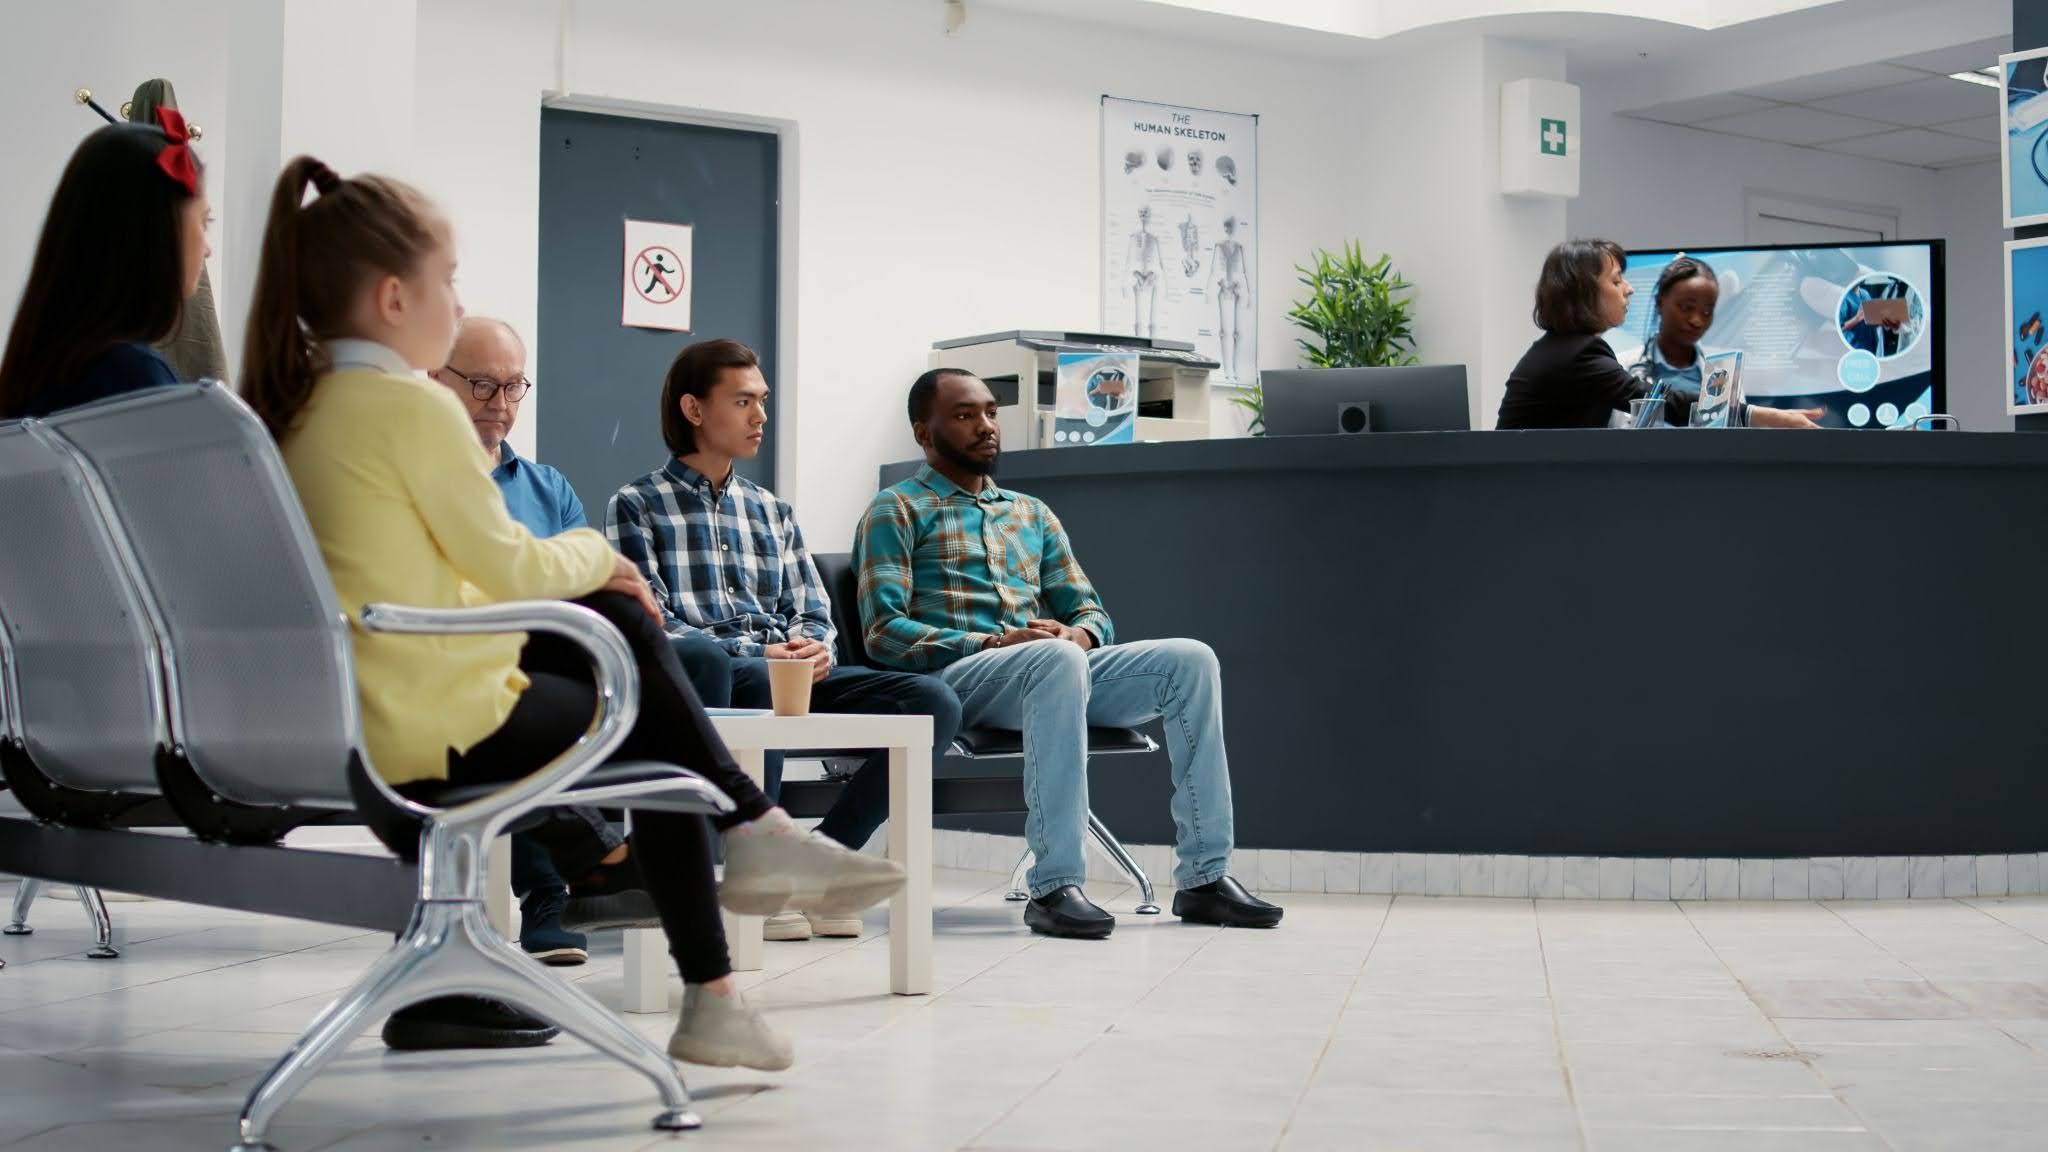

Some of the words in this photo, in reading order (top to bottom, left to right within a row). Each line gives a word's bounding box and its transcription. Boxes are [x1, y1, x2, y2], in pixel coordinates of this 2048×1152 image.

[1172, 113, 1191, 124] THE
[1134, 122, 1171, 135] HUMAN
[1174, 127, 1226, 141] SKELETON
